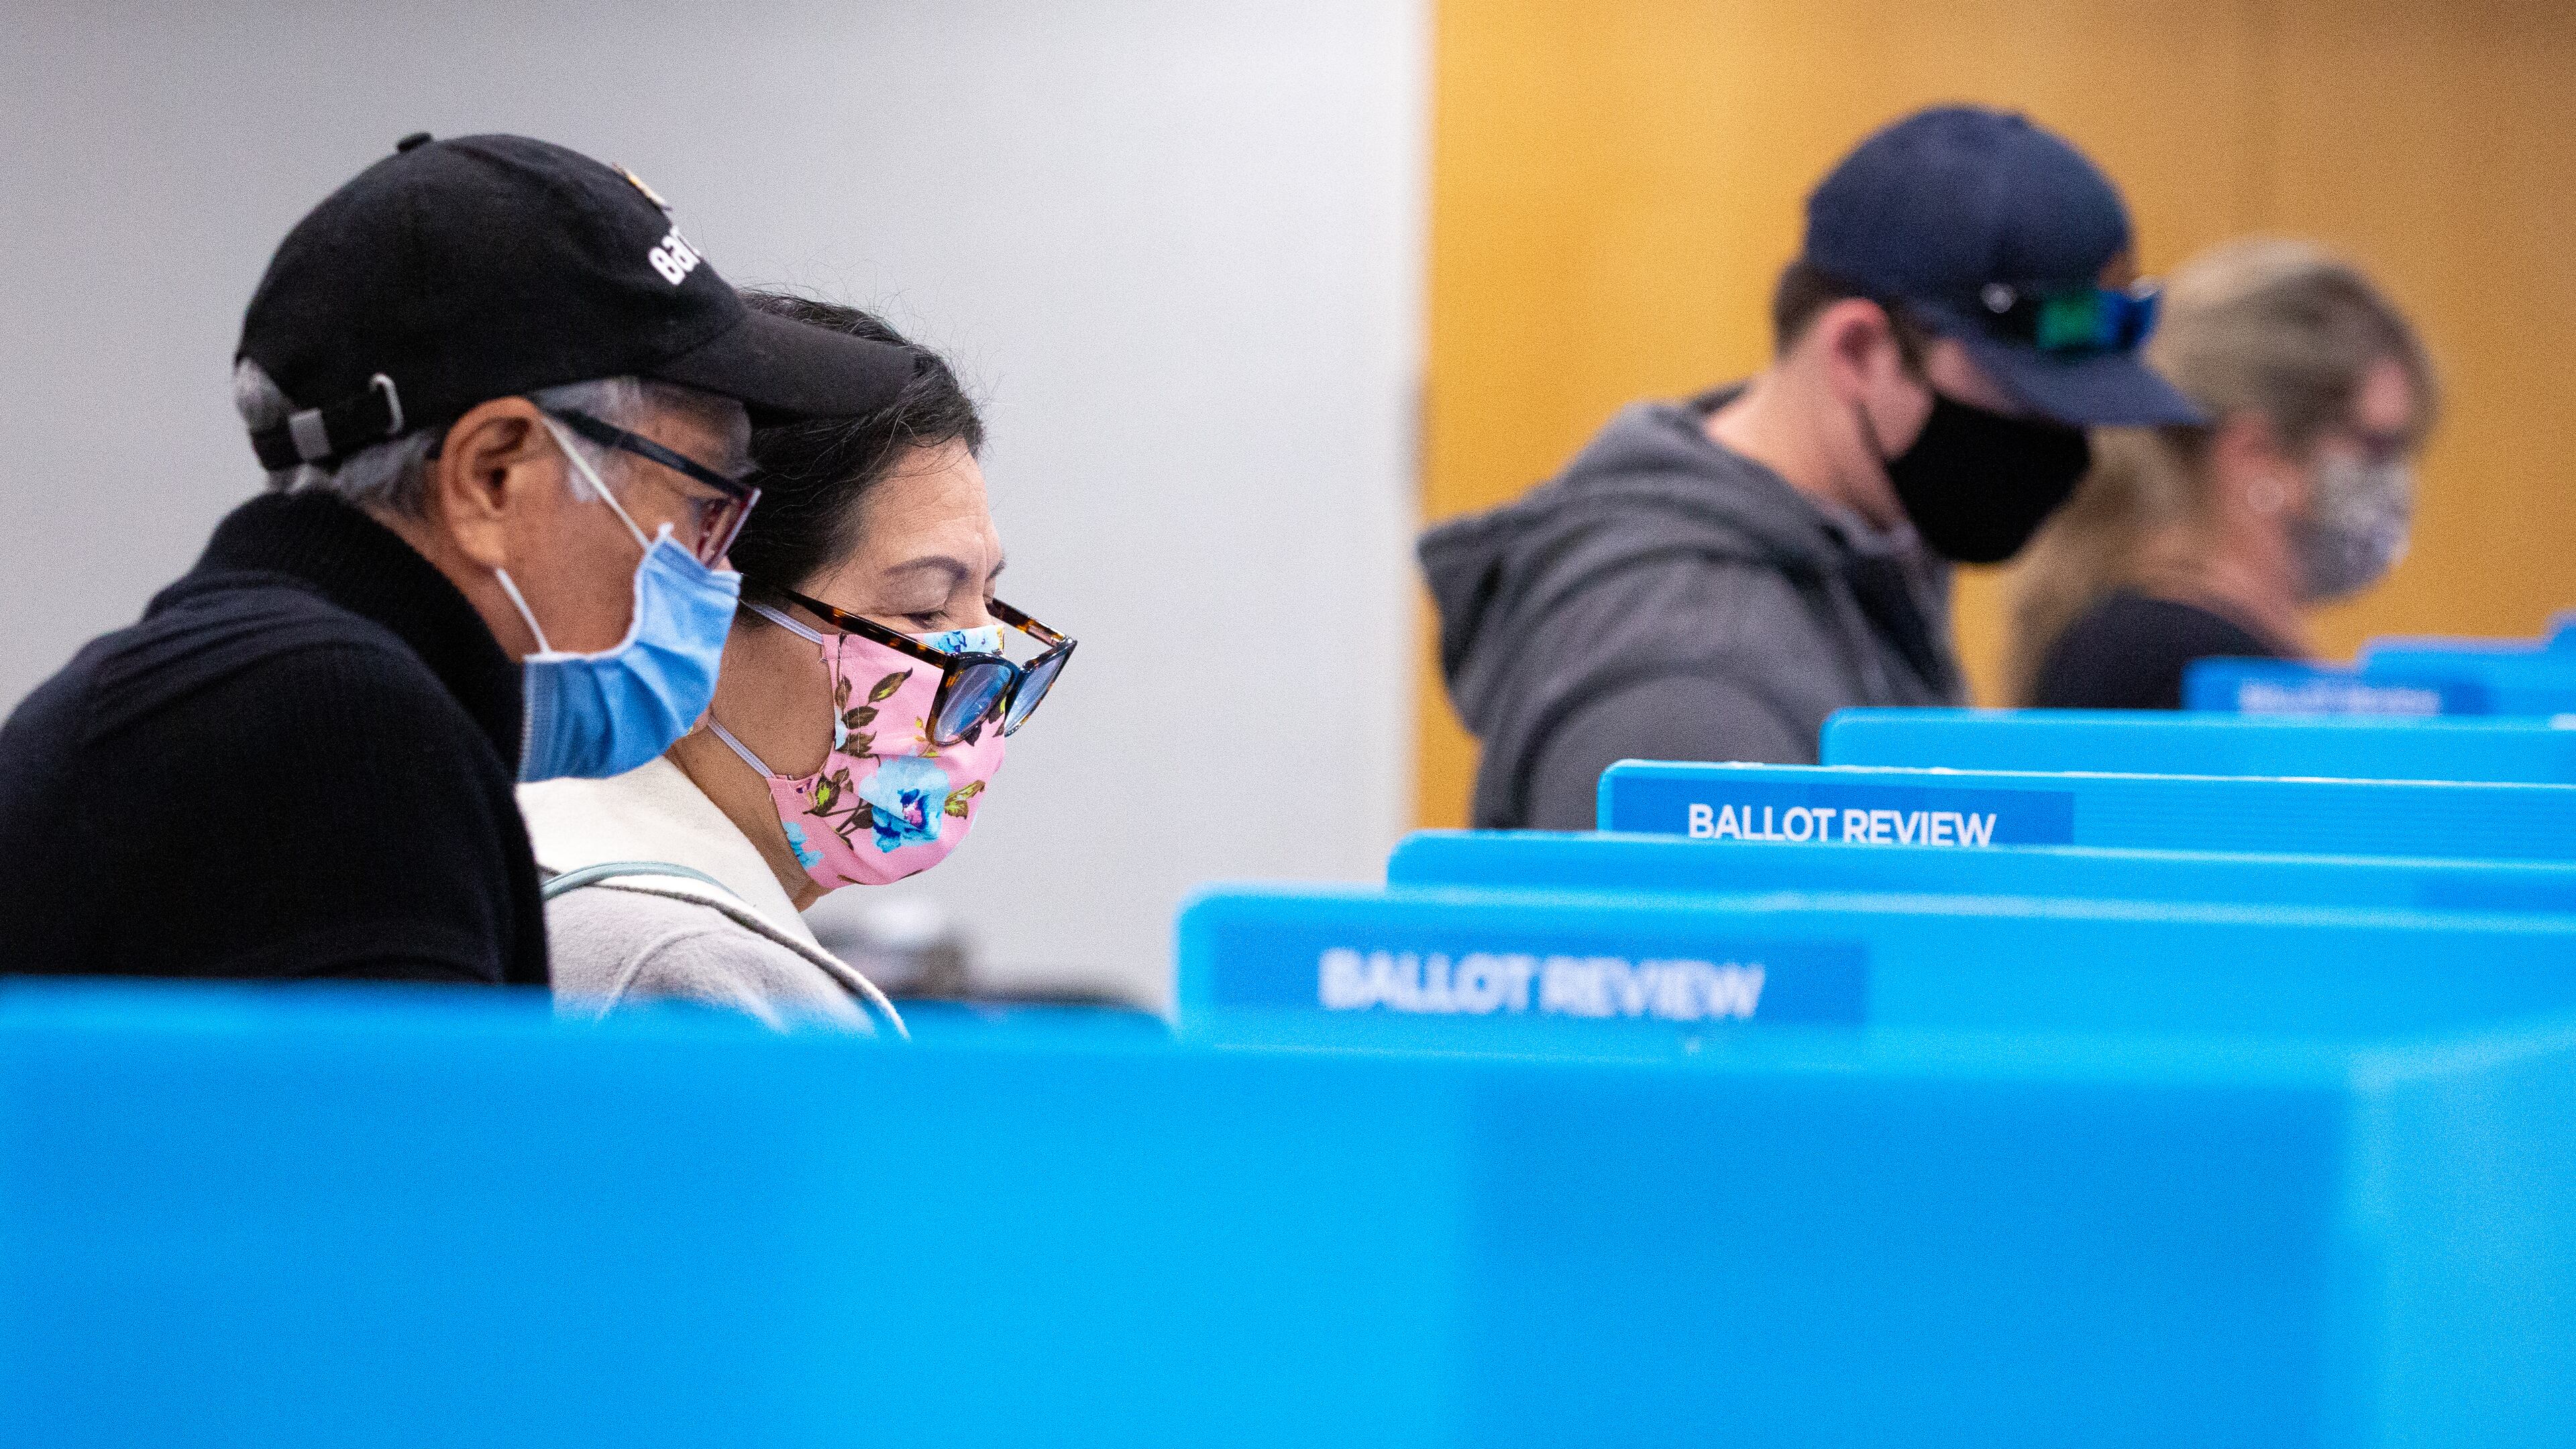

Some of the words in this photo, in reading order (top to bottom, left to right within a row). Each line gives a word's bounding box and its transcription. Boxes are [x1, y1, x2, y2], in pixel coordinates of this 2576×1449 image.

[1688, 803, 1837, 843] BALLOT
[1842, 808, 1997, 848] REVIEW
[1320, 948, 1536, 1014] BALLOT
[1540, 954, 1764, 1020] REVIEW
